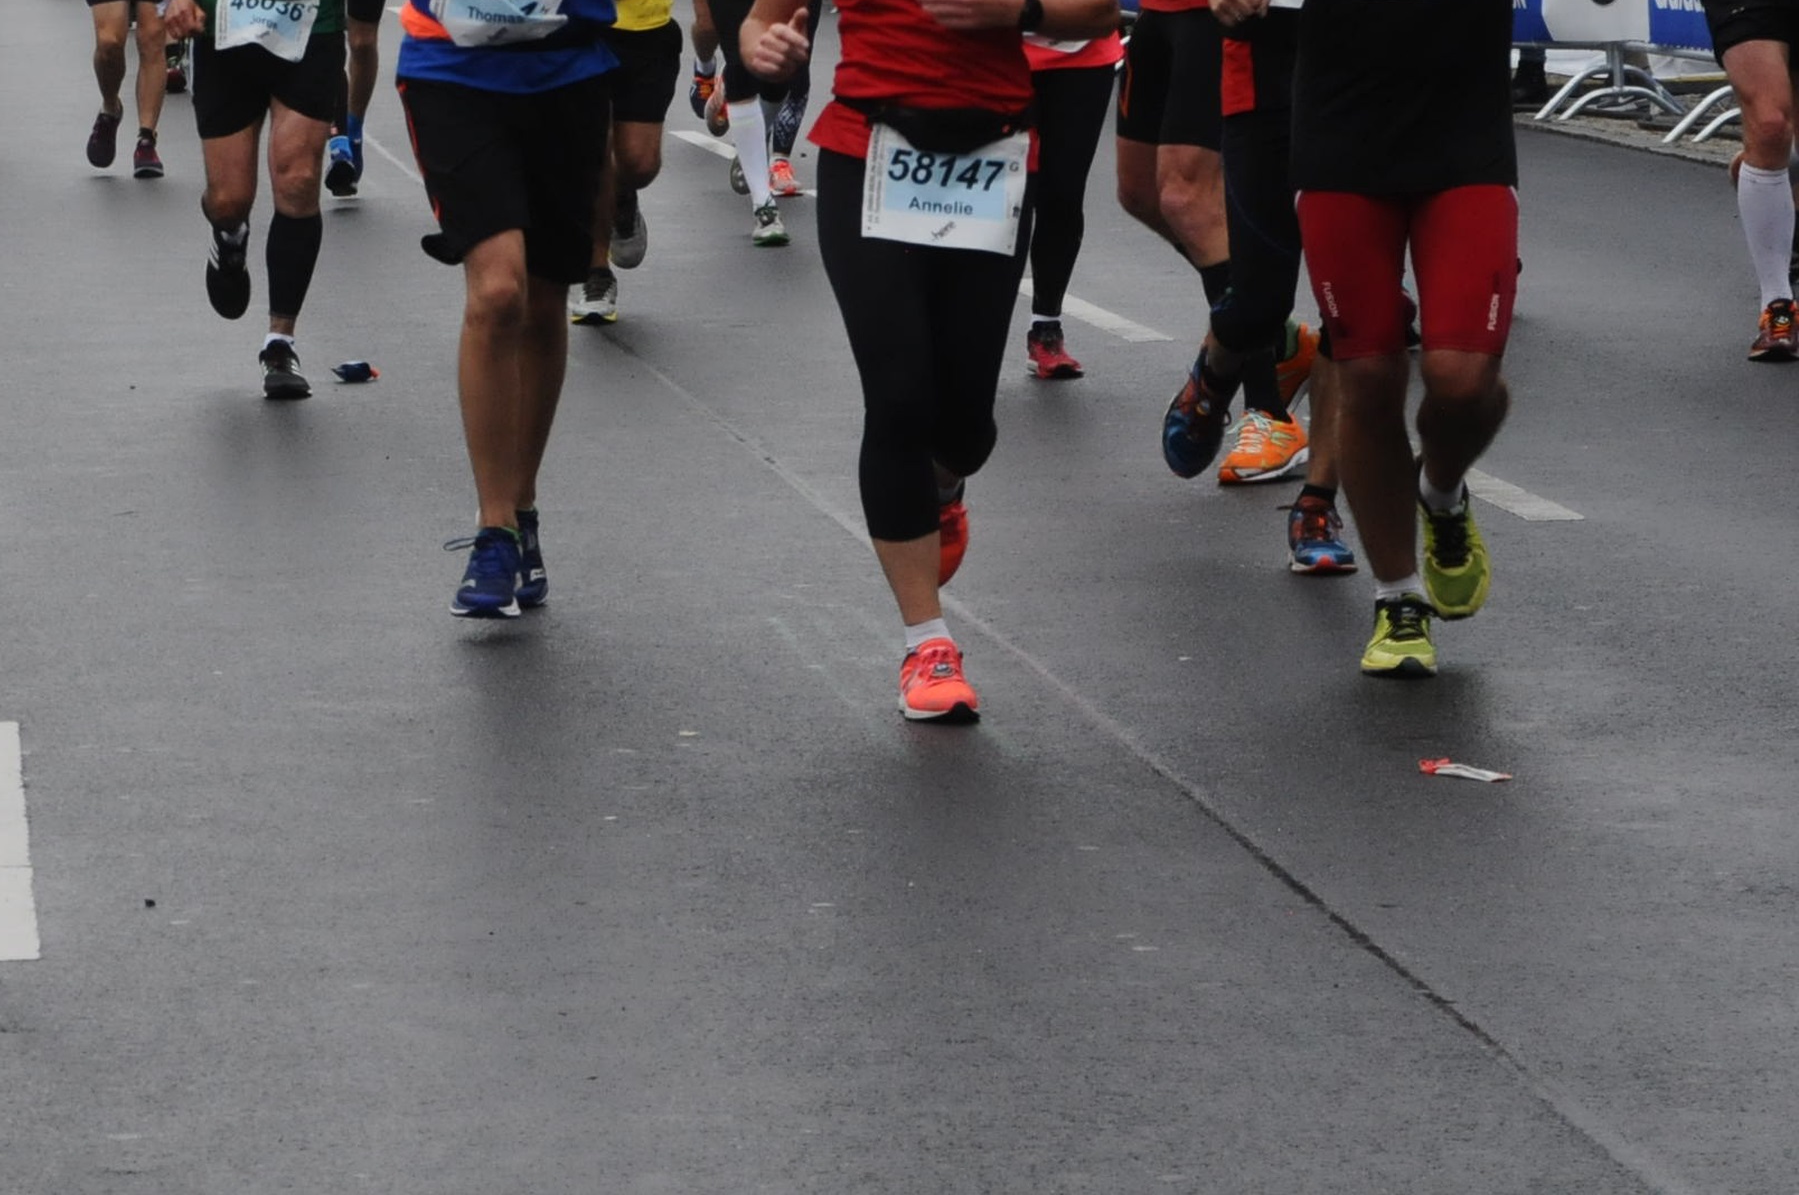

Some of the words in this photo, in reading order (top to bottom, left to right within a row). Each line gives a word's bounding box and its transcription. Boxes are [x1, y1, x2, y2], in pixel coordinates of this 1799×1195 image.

[466, 5, 526, 25] Thomas
[887, 148, 1006, 192] 58147
[908, 196, 974, 216] Annelie
[1321, 280, 1341, 318] FUSION
[1486, 293, 1500, 331] FUSION
